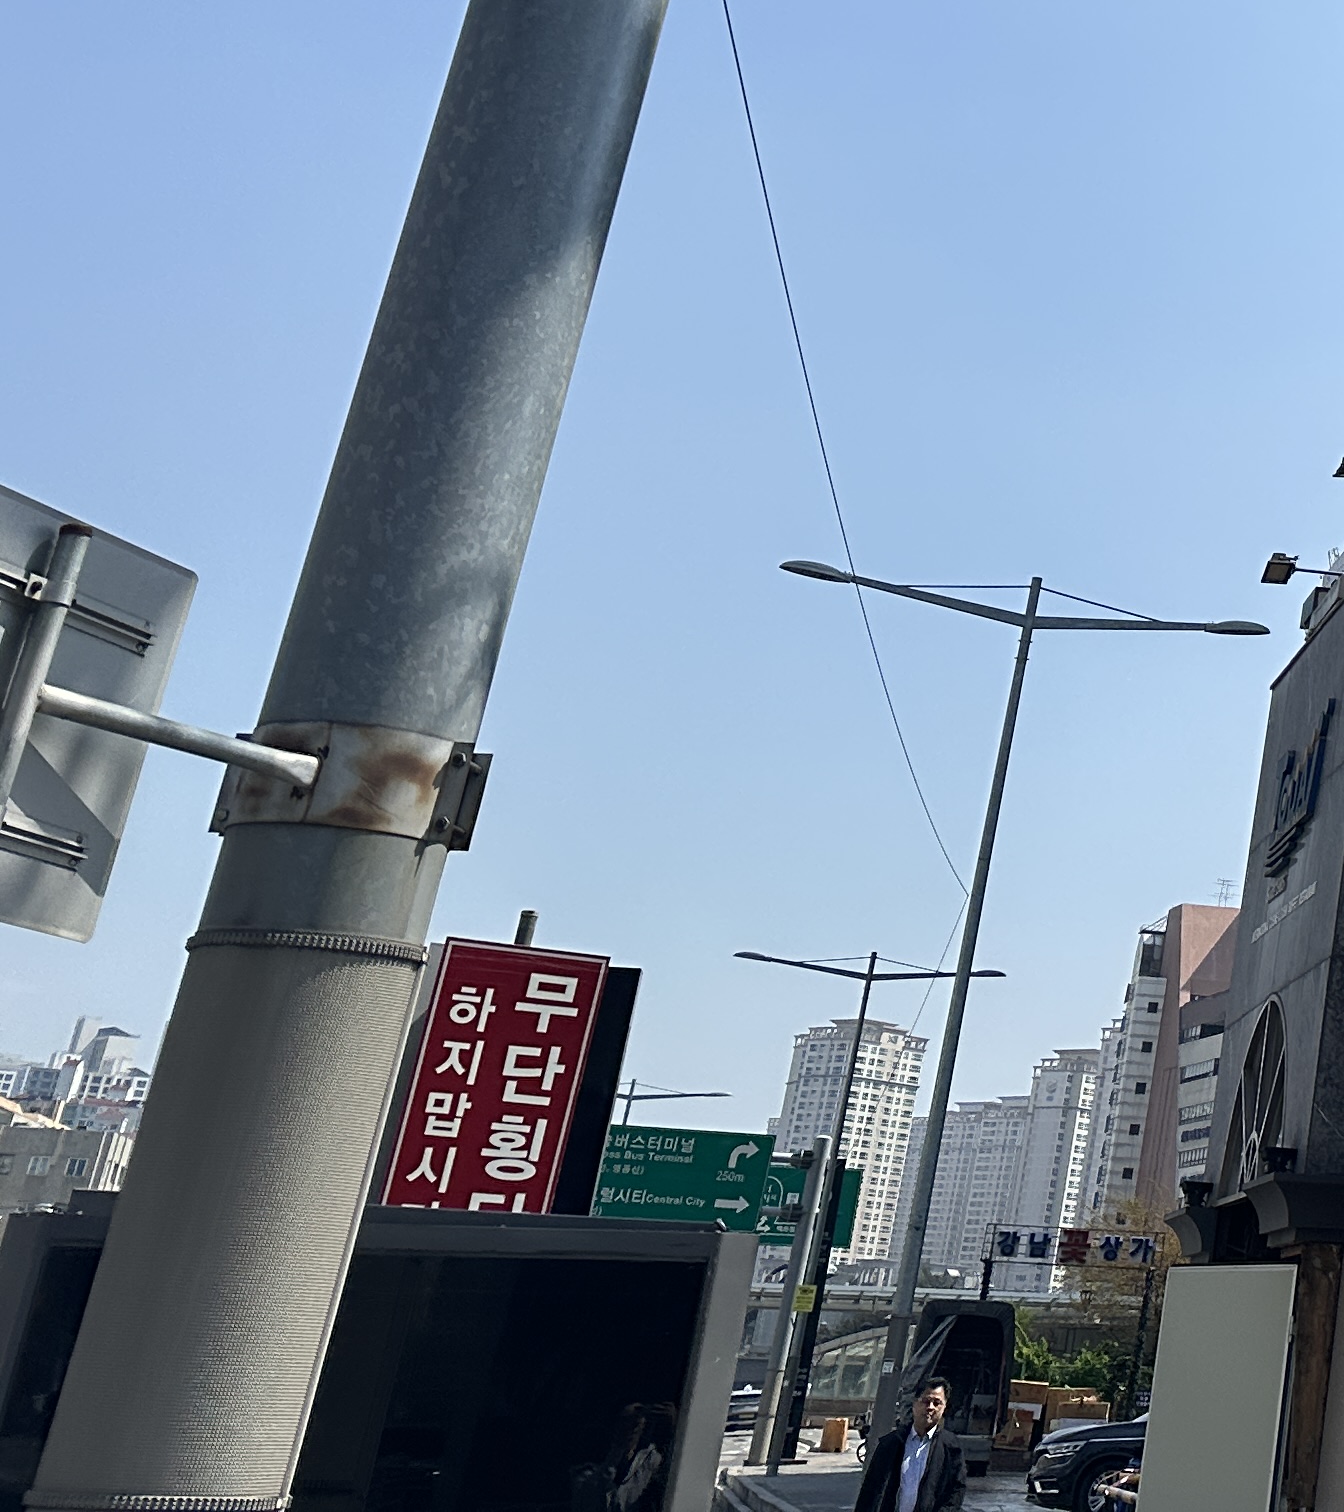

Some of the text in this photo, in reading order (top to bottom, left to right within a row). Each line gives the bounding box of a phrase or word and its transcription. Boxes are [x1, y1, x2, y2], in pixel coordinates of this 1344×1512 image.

[400, 985, 497, 1211] 하지맙시
[466, 972, 579, 1214] 무단횡
[624, 1150, 645, 1161] Bus
[648, 1152, 694, 1164] Terminal
[715, 1169, 745, 1184] 250m
[597, 1186, 647, 1205] 럴시티
[686, 1195, 706, 1208] City
